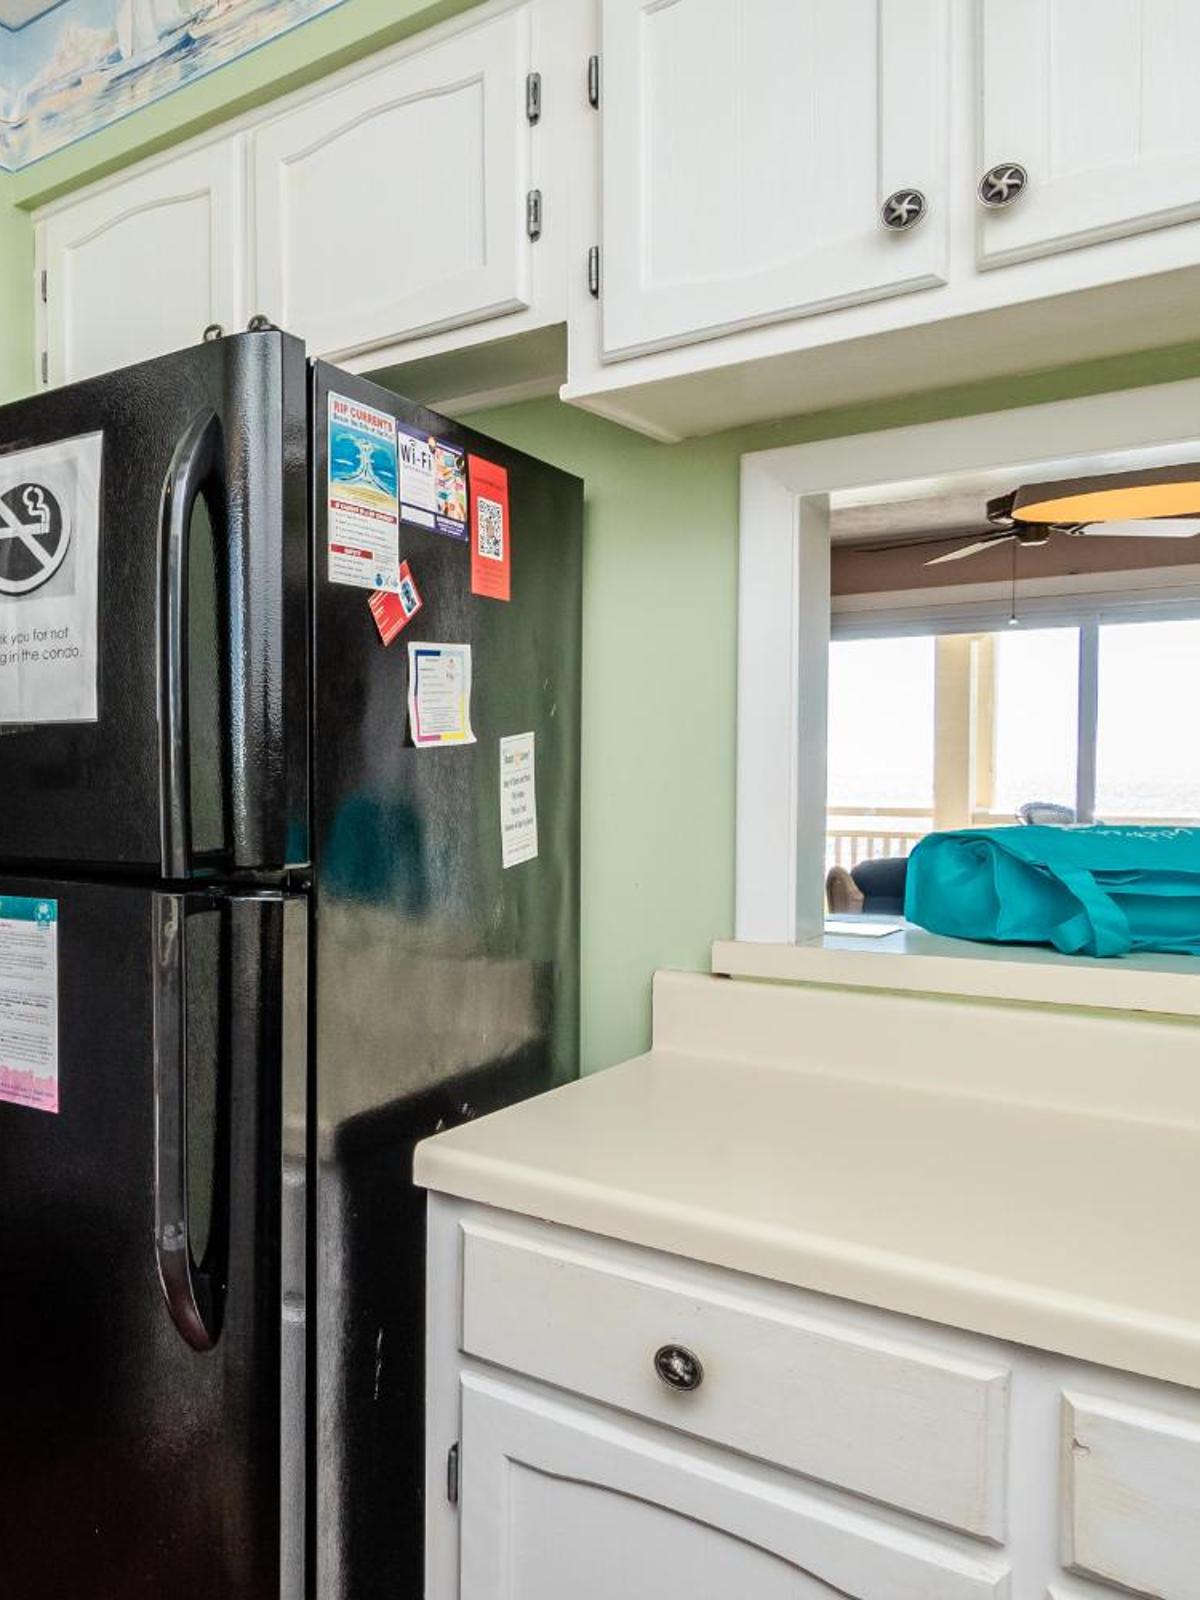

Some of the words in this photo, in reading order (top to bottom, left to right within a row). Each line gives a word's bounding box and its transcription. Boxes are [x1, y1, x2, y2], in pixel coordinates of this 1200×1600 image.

[350, 406, 393, 433] CURRENTS
[400, 443, 432, 472] Wi-Fi
[11, 632, 30, 646] you
[32, 627, 48, 641] for
[50, 626, 69, 640] not
[9, 650, 20, 663] in
[21, 648, 40, 661] the
